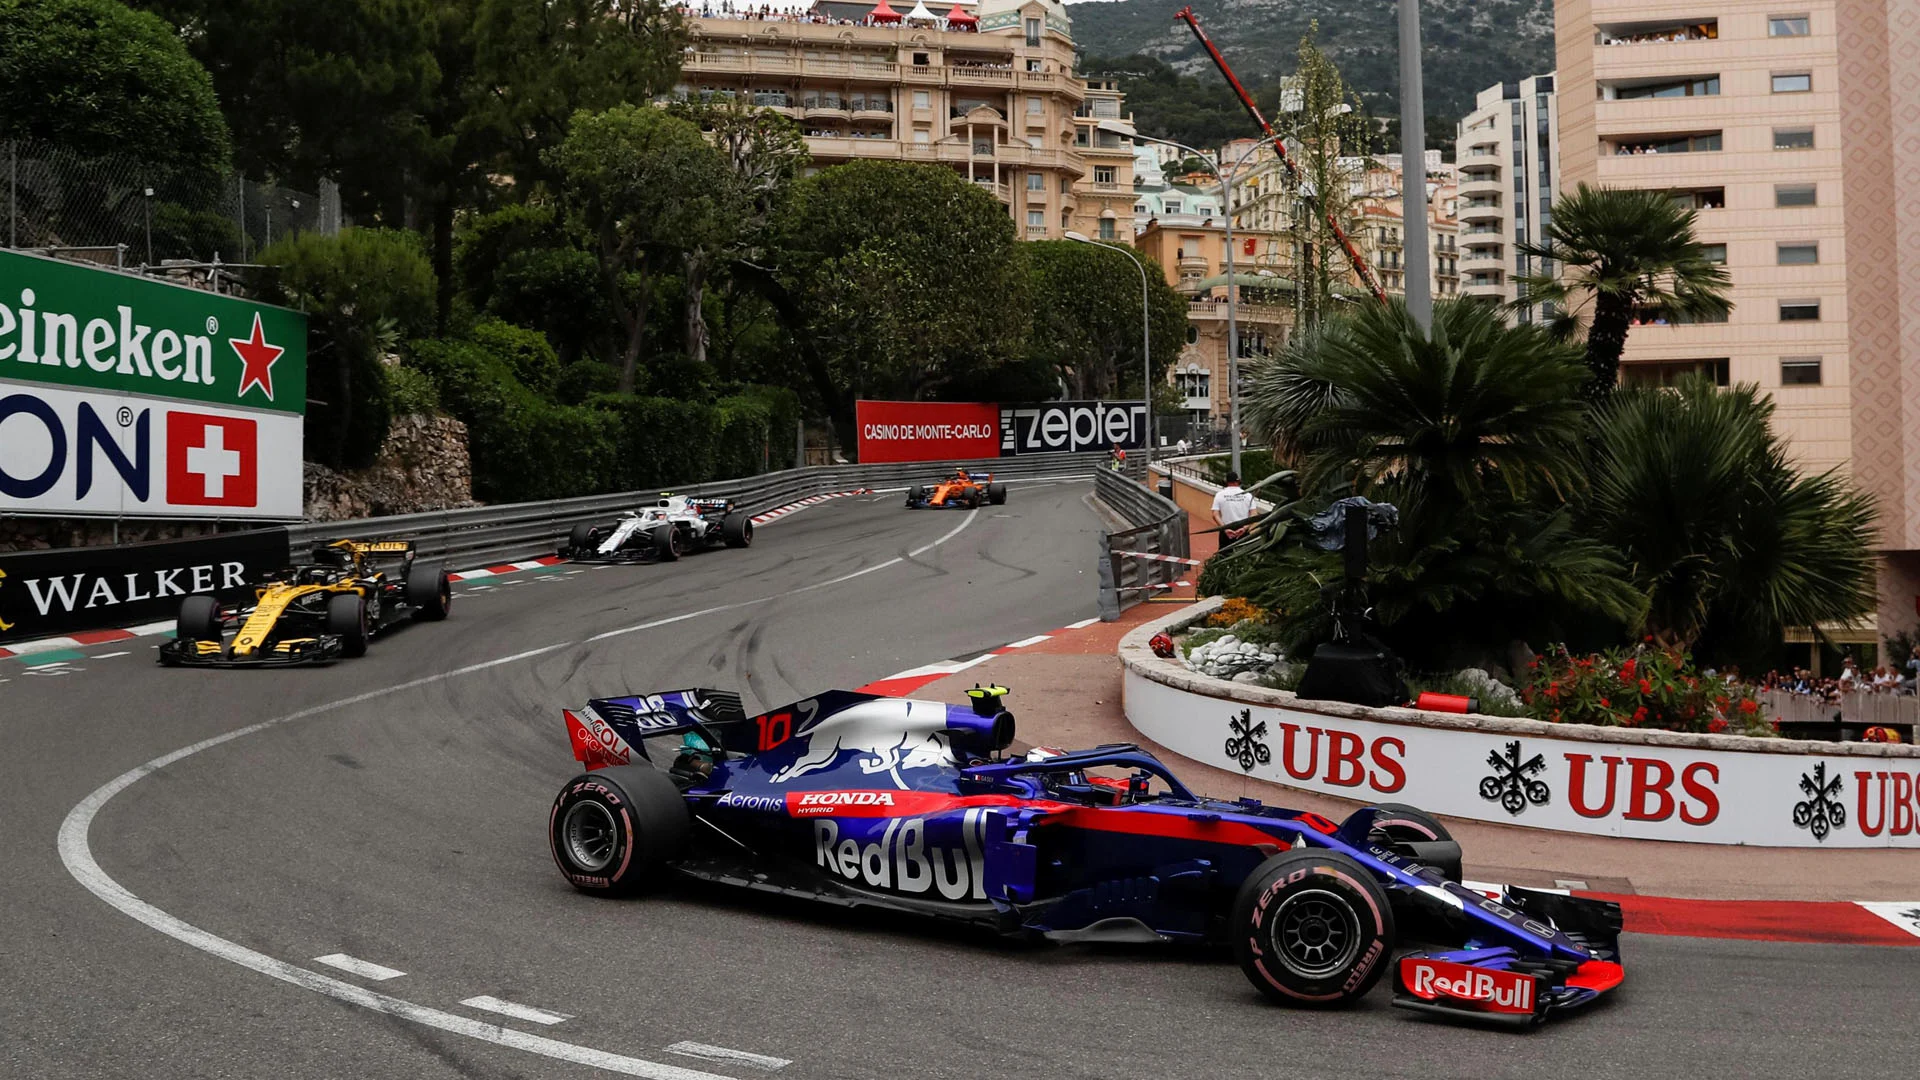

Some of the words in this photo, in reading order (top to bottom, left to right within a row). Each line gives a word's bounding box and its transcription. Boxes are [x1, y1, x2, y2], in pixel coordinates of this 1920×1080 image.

[864, 424, 899, 440] CASINO
[900, 425, 915, 439] DE
[916, 424, 991, 440] MONTE-CARLO
[1015, 402, 1148, 452] zepter
[23, 561, 246, 616] WALKER
[592, 719, 631, 764] COLA
[756, 713, 792, 750] 10
[1278, 722, 1406, 793] UBS
[572, 782, 621, 805] ZERO
[716, 792, 783, 812] Acronis
[797, 806, 834, 814] HYBRID
[799, 793, 895, 806] HONDA
[1563, 753, 1720, 825] UBS
[1854, 771, 1920, 837] UB
[1252, 868, 1307, 929] ZERO
[1250, 937, 1263, 956] P
[1343, 939, 1385, 993] PIRELLI
